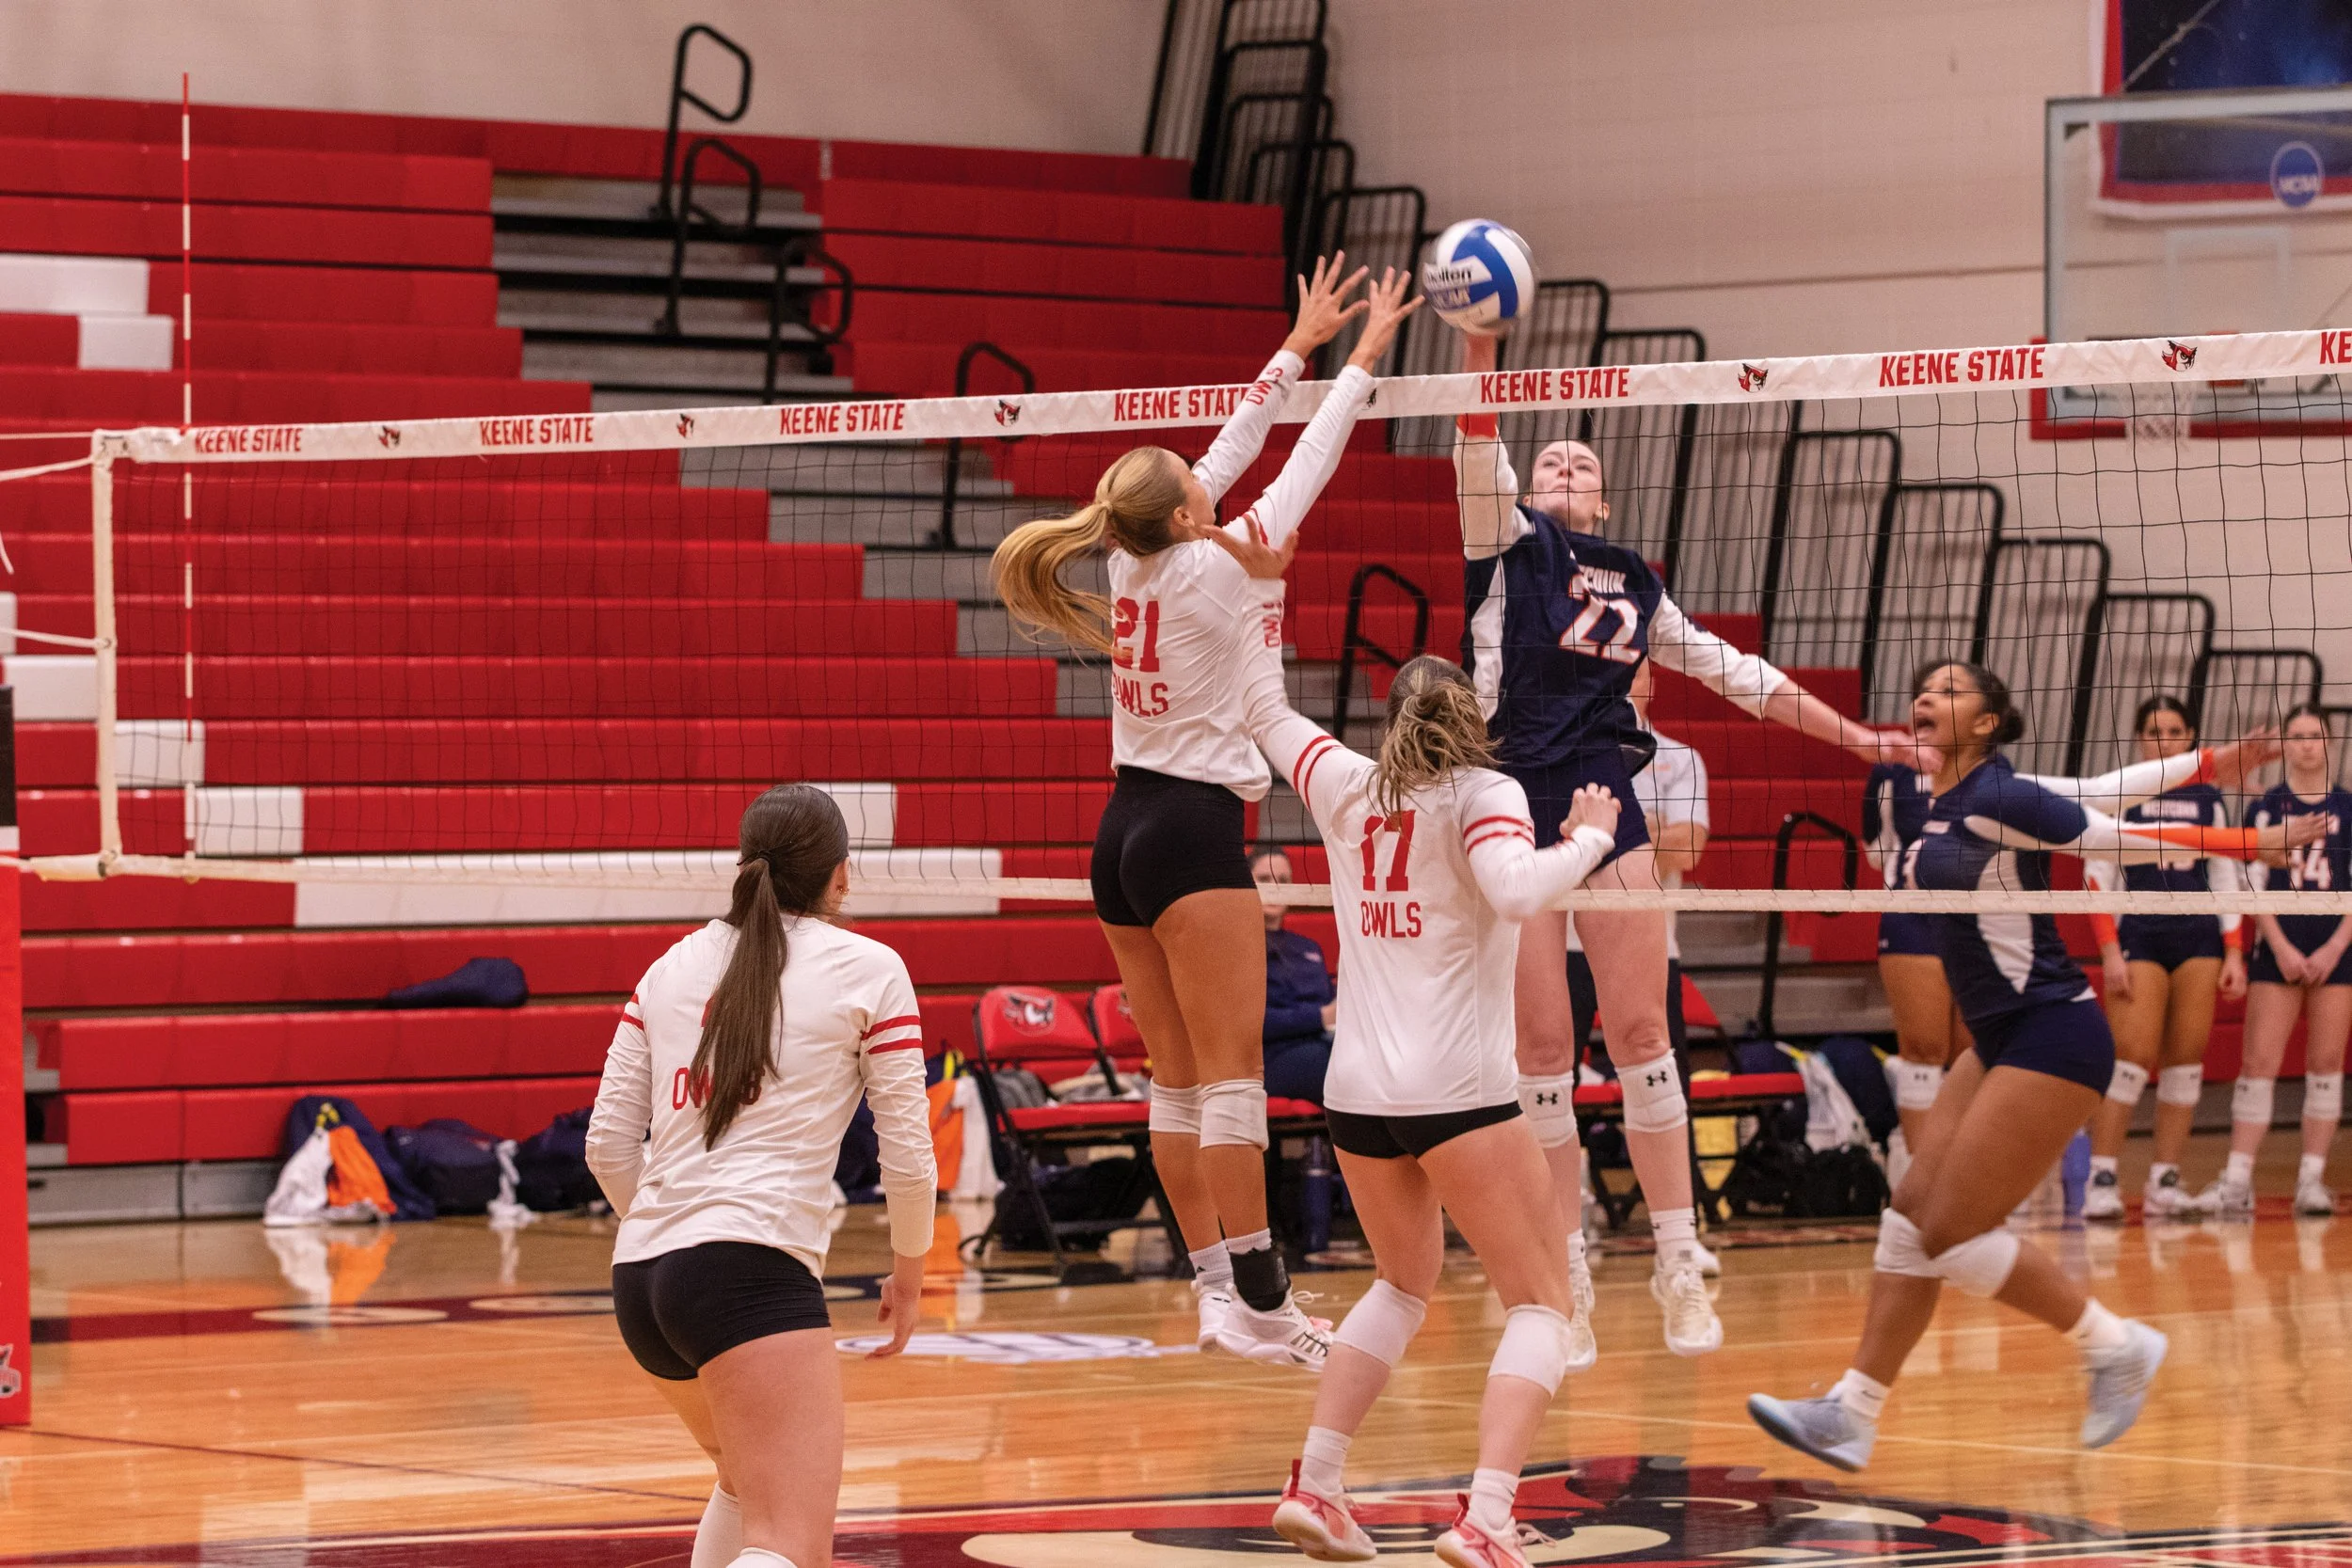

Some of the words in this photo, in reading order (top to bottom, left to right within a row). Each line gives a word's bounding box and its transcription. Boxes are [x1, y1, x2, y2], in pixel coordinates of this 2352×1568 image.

[1480, 371, 1552, 404] KEENE
[1559, 367, 1629, 400] STATE
[1879, 352, 1960, 388] KEENE
[1967, 346, 2045, 382] STATE
[780, 404, 840, 435] KEENE
[846, 403, 905, 432] STATE
[1114, 389, 1180, 421] KEENE
[195, 429, 248, 453] KEENE
[252, 427, 303, 452] STATE
[480, 418, 534, 446] KEENE
[539, 416, 594, 444] STATE
[1113, 596, 1160, 673] 21
[1558, 572, 1641, 666] 22
[1360, 810, 1416, 892] 17
[1360, 900, 1422, 939] OWLS
[672, 1065, 766, 1111] OWS
